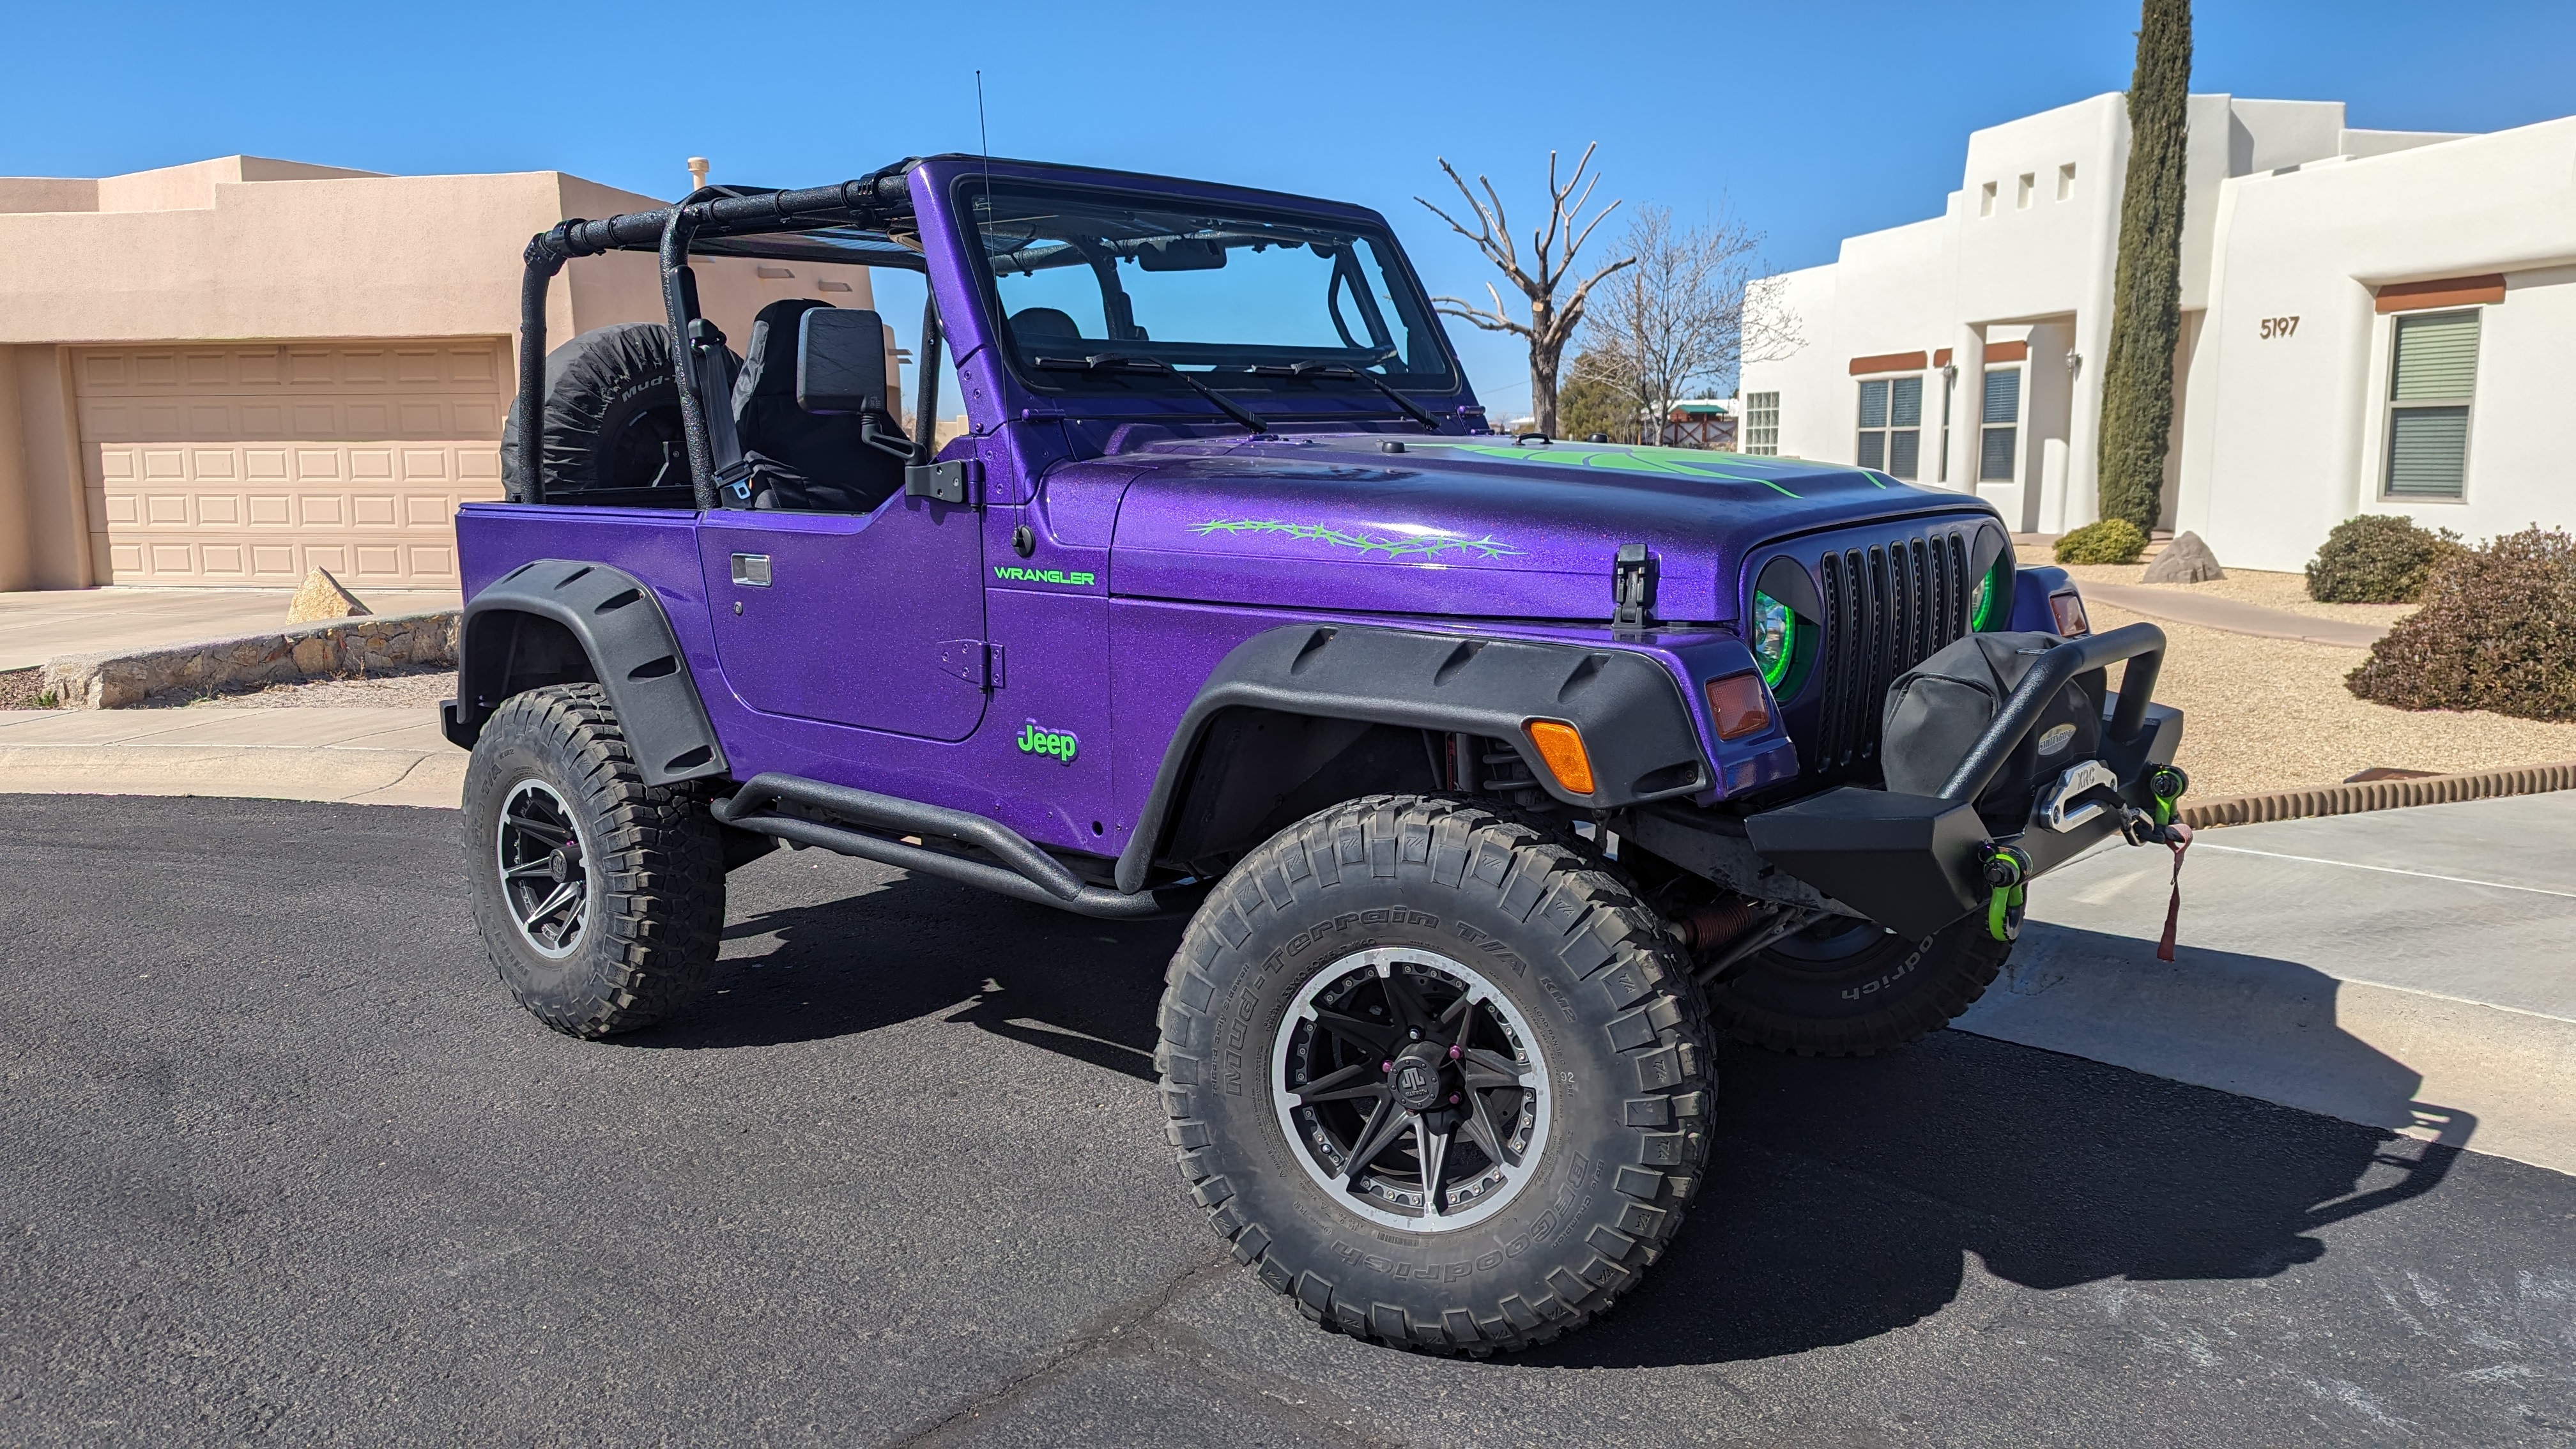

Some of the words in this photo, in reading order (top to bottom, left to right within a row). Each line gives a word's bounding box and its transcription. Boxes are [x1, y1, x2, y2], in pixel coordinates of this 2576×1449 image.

[2260, 316, 2300, 339] 5197
[994, 567, 1094, 585] WRANGLER
[1017, 724, 1077, 762] Jeep
[481, 763, 503, 795] T/A
[2077, 766, 2096, 791] XRC
[1223, 962, 1251, 1011] Sidewall
[1457, 921, 1526, 979] T/A
[1540, 977, 1577, 1022] KM2
[1842, 930, 1938, 1000] odrich
[1533, 1005, 1549, 1028] LOAD
[1547, 1027, 1564, 1057] RANGE
[1591, 1159, 1604, 1190] Baja
[1331, 1151, 1590, 1284] BFGoodrich
[1552, 1195, 1592, 1250] Champion
